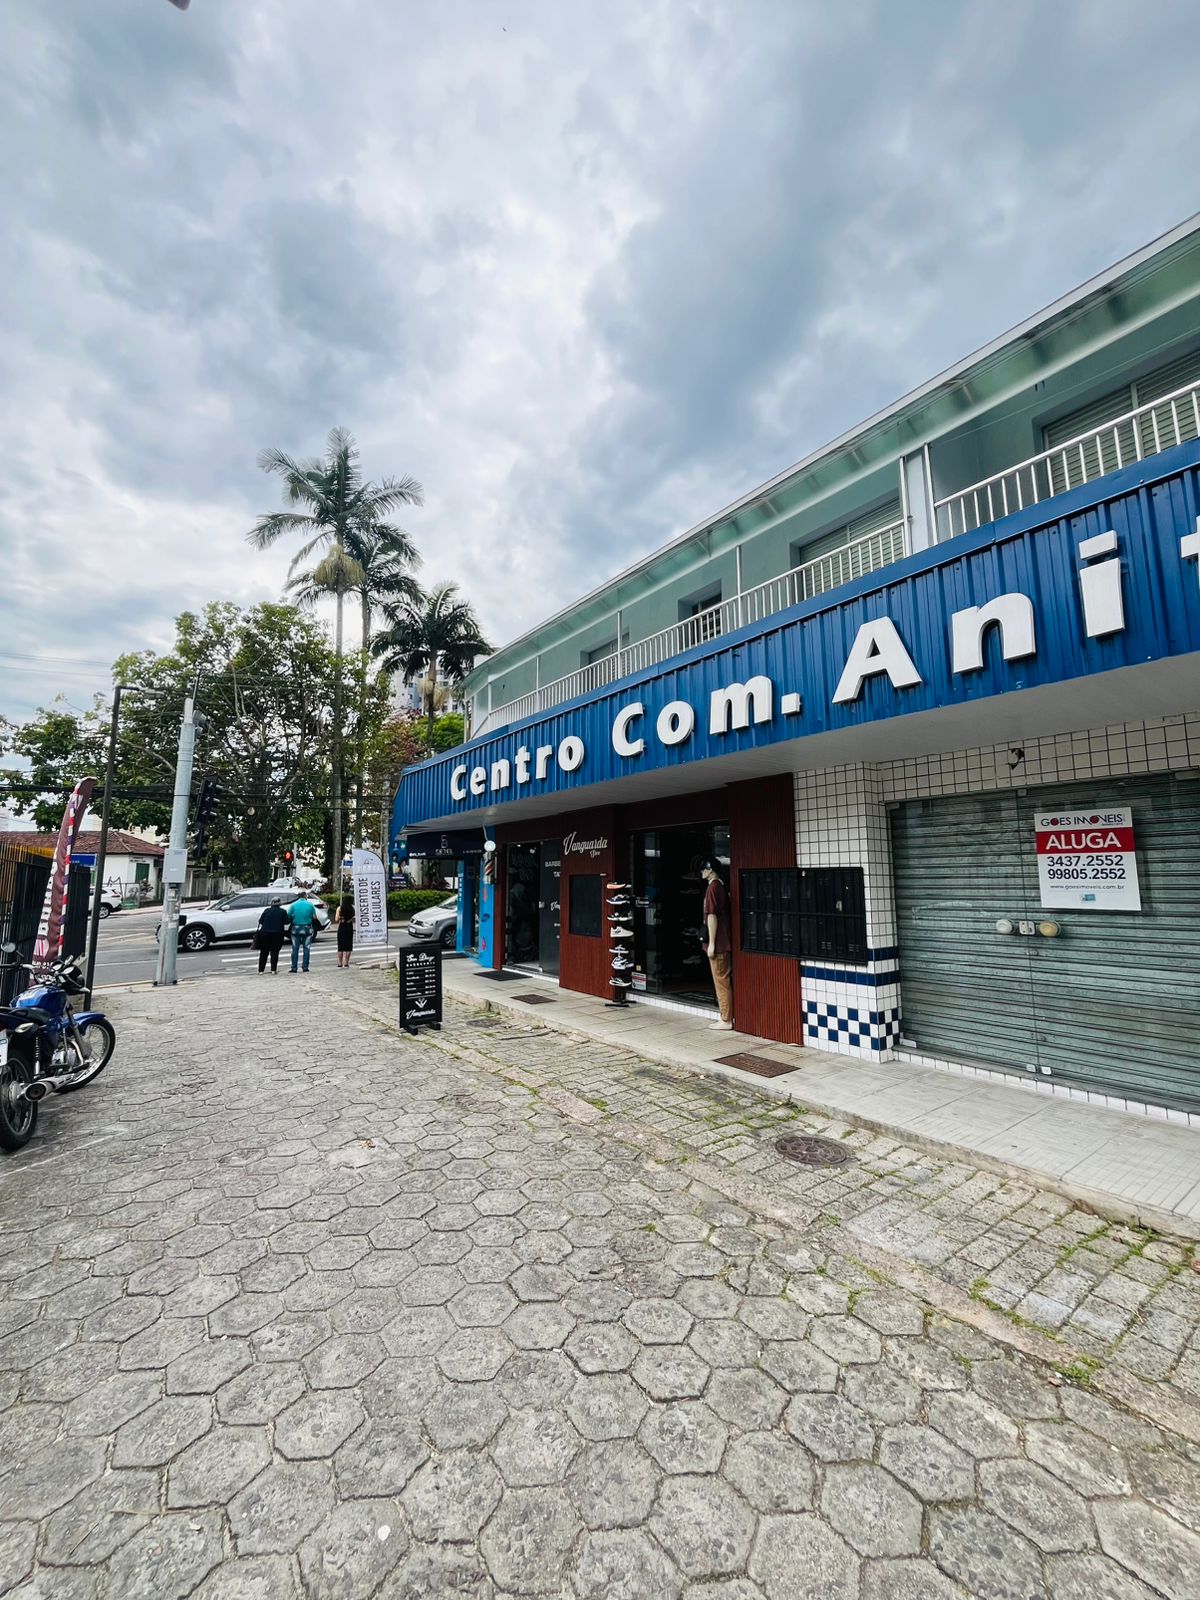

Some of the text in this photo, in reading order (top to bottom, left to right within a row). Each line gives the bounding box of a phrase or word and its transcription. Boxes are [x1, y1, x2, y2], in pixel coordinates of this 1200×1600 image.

[450, 735, 585, 801] Centro
[612, 675, 801, 757] Com.
[563, 831, 608, 856] Vanguarda
[1045, 832, 1122, 850] ALUGA
[1047, 855, 1124, 867] 3437.2552
[1048, 868, 1126, 880] 99805.2552
[358, 877, 370, 927] CONSERTO DE
[371, 880, 382, 923] CELULARES
